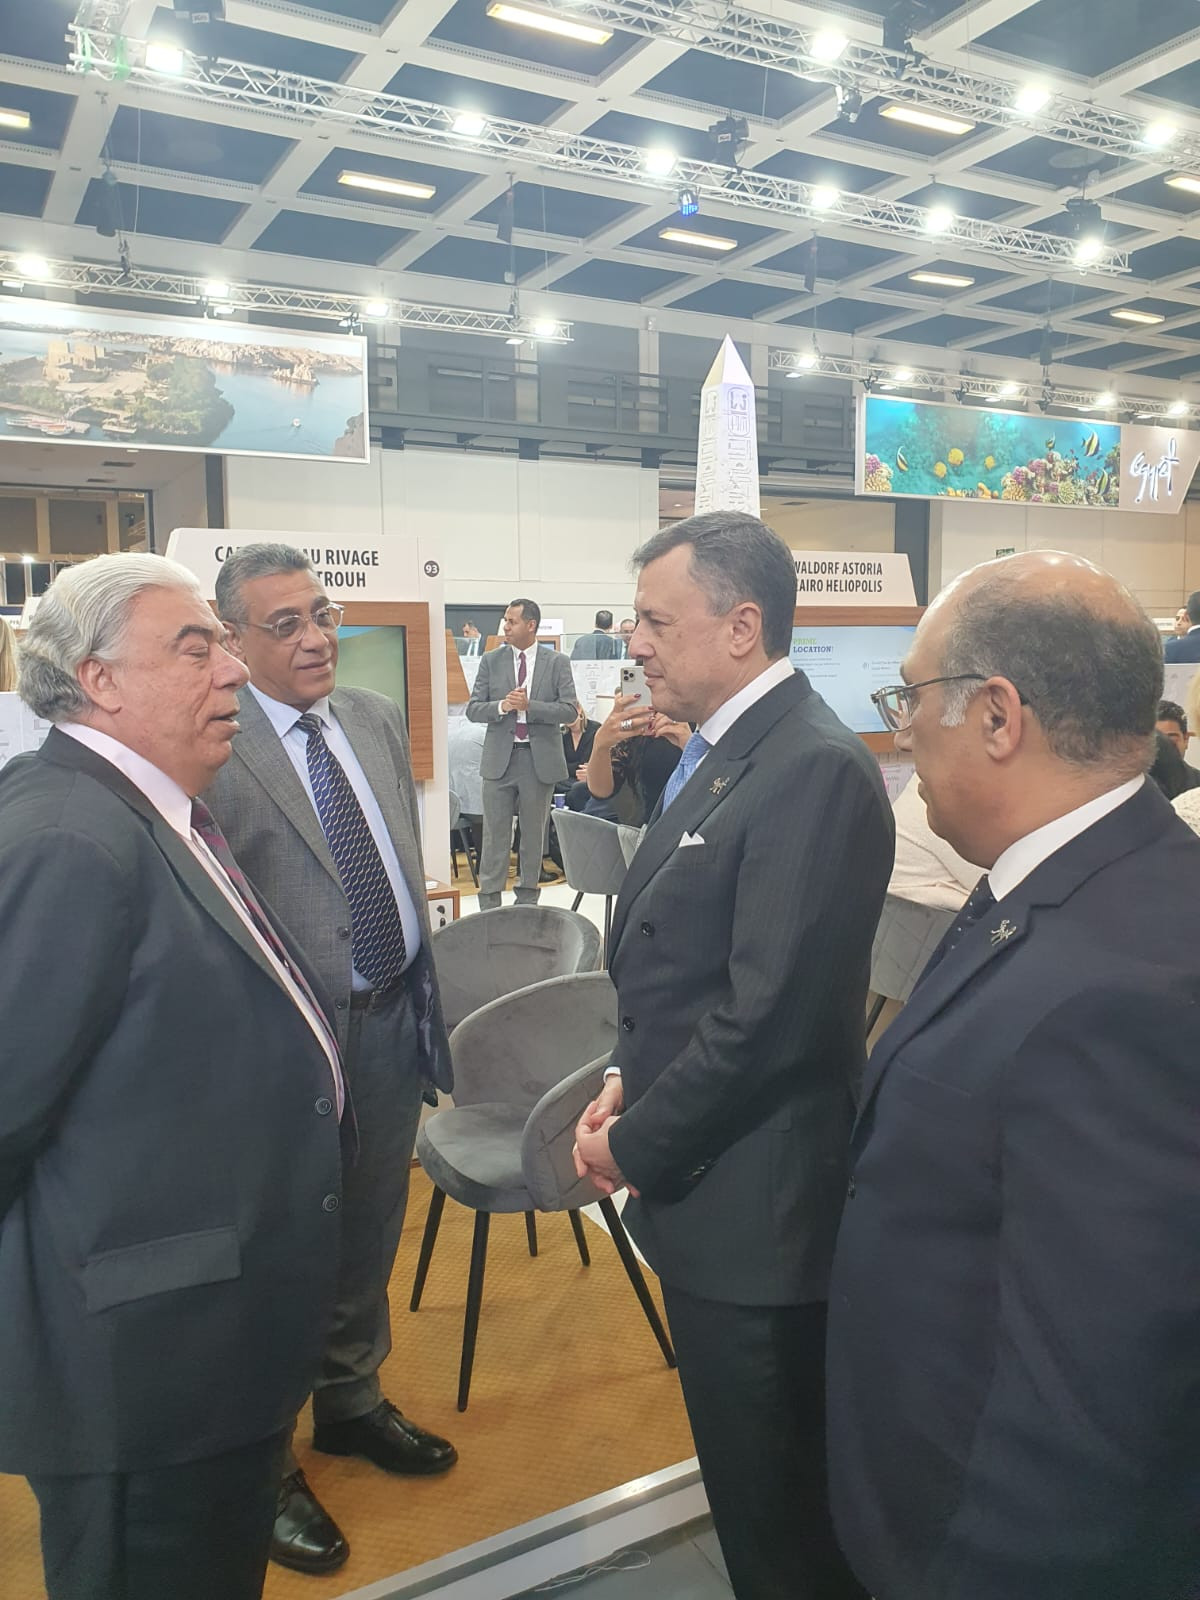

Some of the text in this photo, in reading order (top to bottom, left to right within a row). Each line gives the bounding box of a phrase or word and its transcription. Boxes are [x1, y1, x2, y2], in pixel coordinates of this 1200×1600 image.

[325, 549, 379, 566] RIVAGE
[425, 564, 438, 574] 93
[842, 562, 883, 576] ASTORIA
[316, 570, 366, 588] TROUH
[797, 579, 883, 593] AIRO HELIOPOLIS
